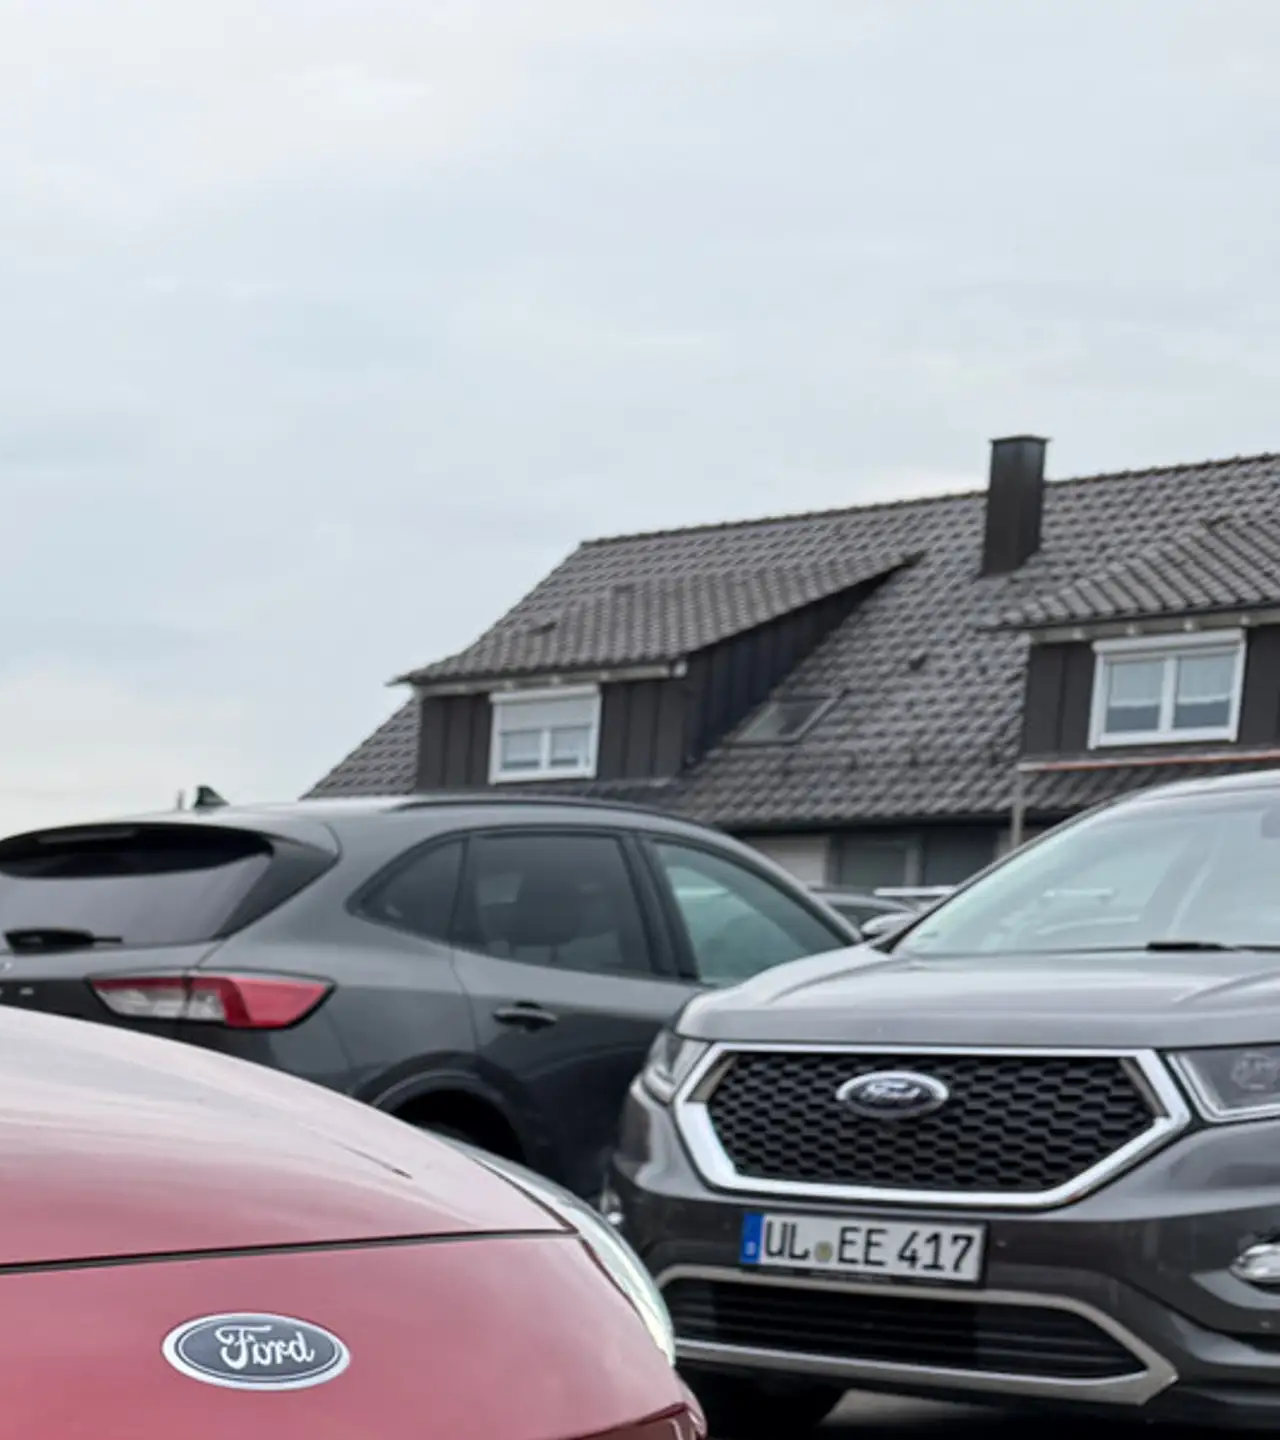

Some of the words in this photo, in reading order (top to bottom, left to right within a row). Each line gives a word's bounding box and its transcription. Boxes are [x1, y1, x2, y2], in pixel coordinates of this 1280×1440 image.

[765, 1220, 810, 1260] UL
[837, 1225, 889, 1267] EE
[896, 1230, 975, 1273] 417
[214, 1324, 316, 1370] Ford
